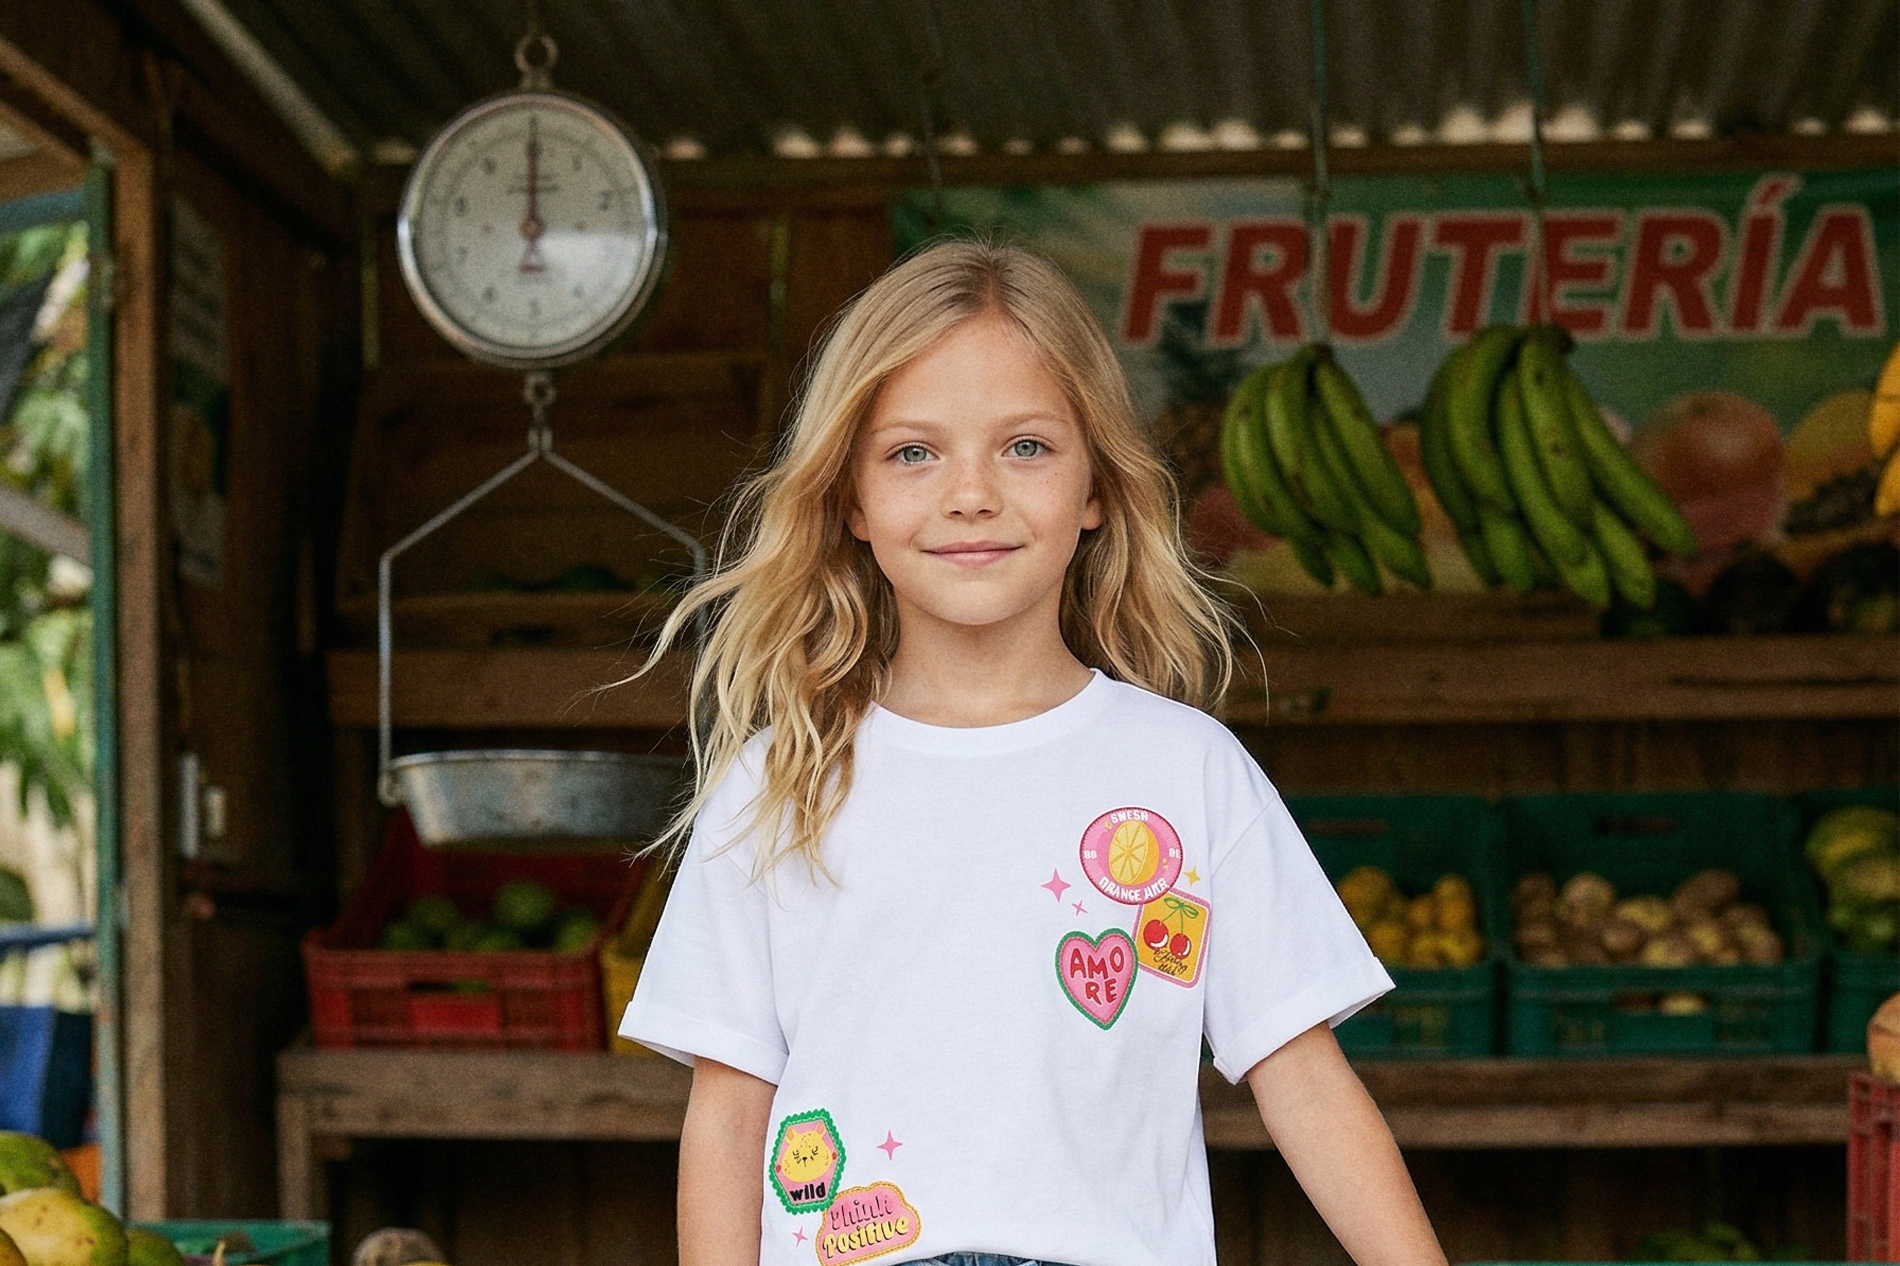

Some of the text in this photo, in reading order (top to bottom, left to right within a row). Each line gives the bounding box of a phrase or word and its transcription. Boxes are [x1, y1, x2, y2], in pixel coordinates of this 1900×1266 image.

[1122, 177, 1884, 343] FRUTERÍA
[1070, 946, 1125, 979] AMO
[1085, 978, 1118, 1005] RE
